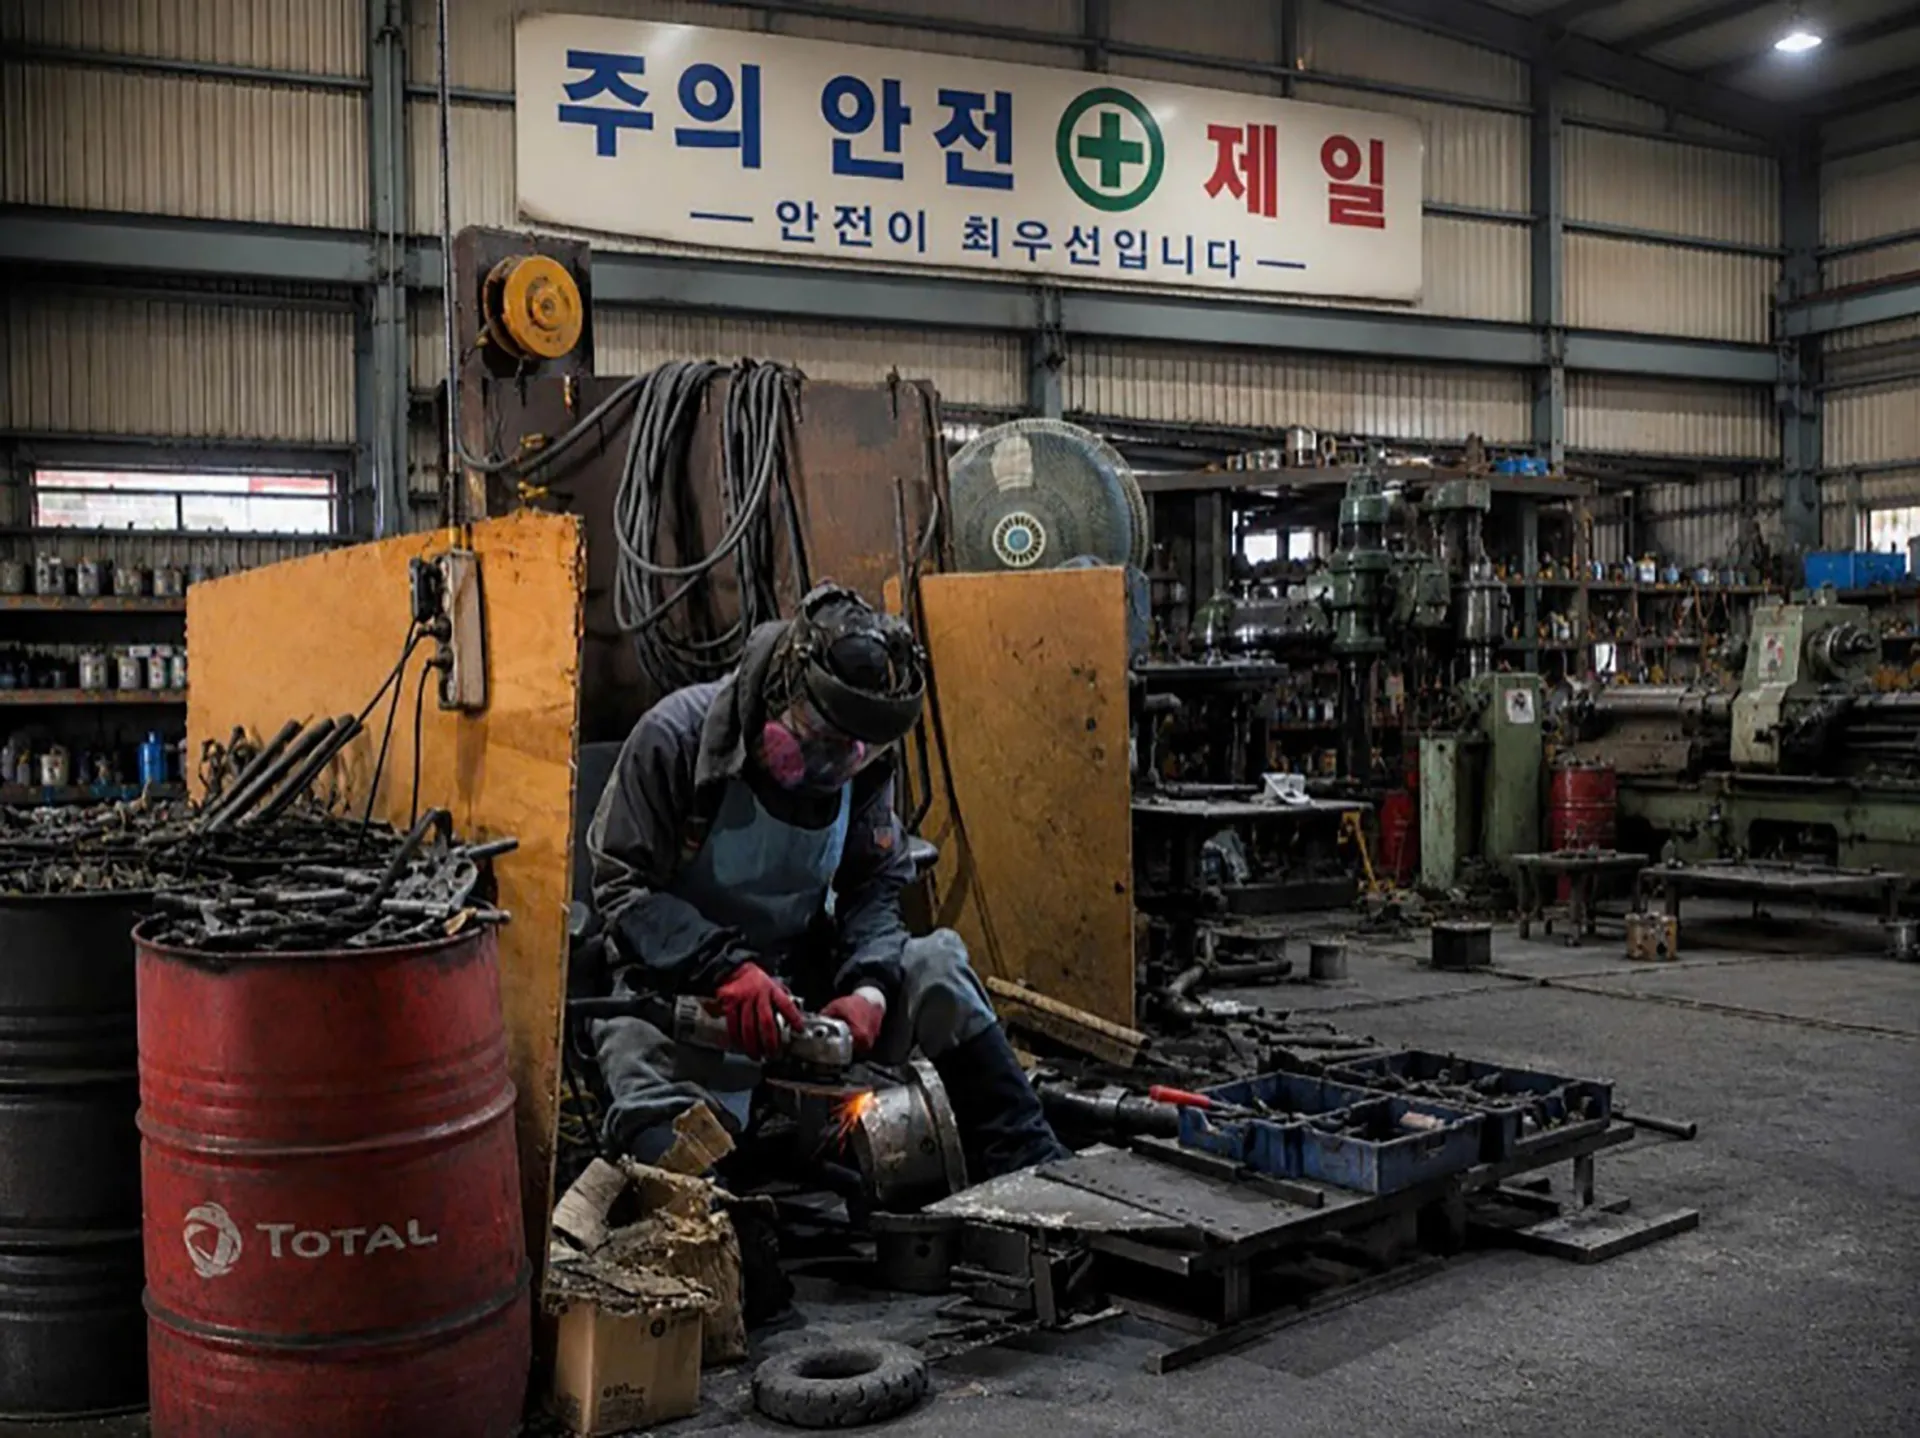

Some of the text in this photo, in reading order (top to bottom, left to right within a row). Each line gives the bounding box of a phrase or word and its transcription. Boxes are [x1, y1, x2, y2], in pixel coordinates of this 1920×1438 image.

[558, 49, 762, 168] 주의
[821, 75, 1015, 189] 안전
[776, 200, 1240, 278] 안전이 최우선입니다
